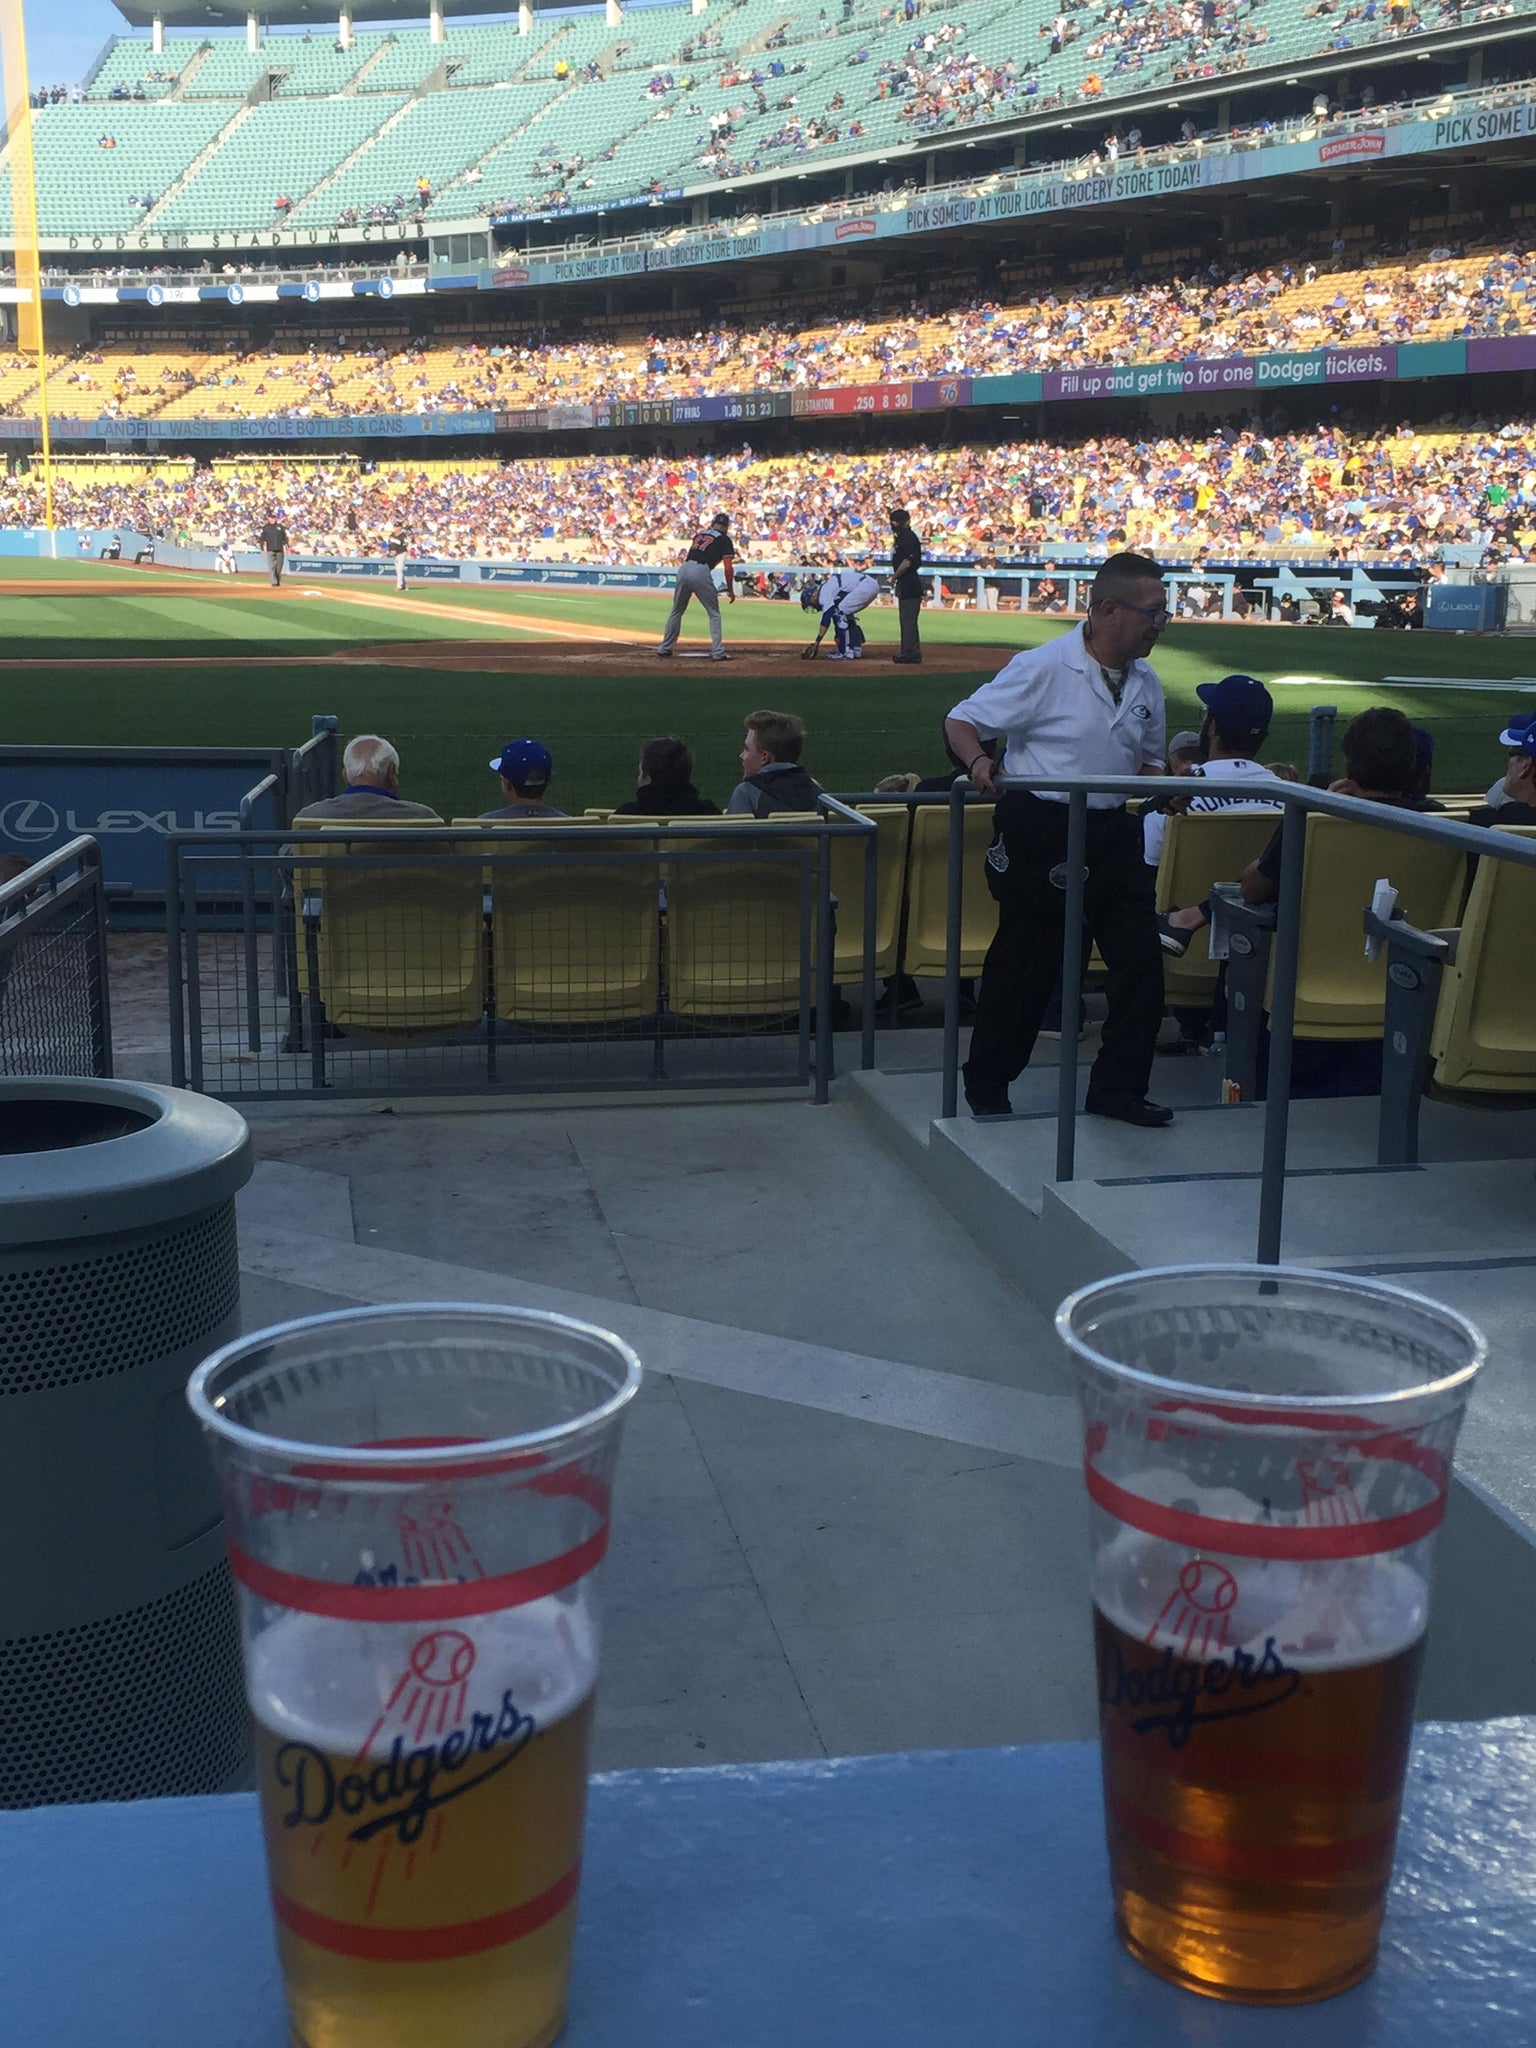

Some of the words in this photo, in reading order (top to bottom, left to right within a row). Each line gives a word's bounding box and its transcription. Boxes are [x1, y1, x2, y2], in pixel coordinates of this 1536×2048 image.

[1435, 117, 1473, 145] PICK
[1477, 108, 1522, 139] SOME
[1528, 107, 1536, 130] U
[1321, 141, 1357, 158] FARMER
[1357, 138, 1383, 150] JOHN
[906, 212, 929, 230] PICK
[932, 207, 959, 226] SOME
[962, 203, 976, 220] UP
[979, 200, 993, 218] AT
[994, 193, 1022, 214] YOUR
[1025, 189, 1059, 213] LOCAL
[1062, 177, 1113, 205] GROCERY
[1116, 171, 1154, 197] STORE
[1157, 163, 1201, 189] TODAY!
[70, 236, 189, 249] DODGER
[212, 230, 340, 248] STADIUM
[363, 224, 424, 241] CLUB
[555, 263, 574, 279] PICK
[576, 260, 597, 278] SOME
[599, 258, 609, 274] UP
[611, 257, 620, 274] AT
[621, 254, 641, 272] YOUR
[670, 244, 704, 265] GROCERY
[706, 240, 731, 260] STORE
[733, 235, 761, 257] TODAY!
[1060, 375, 1079, 393] Fill
[1083, 378, 1101, 394] up
[1105, 371, 1134, 390] and
[1138, 368, 1162, 393] get
[1166, 368, 1194, 386] two
[1198, 366, 1219, 384] for
[1223, 366, 1253, 382] one
[1258, 360, 1322, 382] Dodger
[1325, 353, 1388, 375] tickets.
[805, 397, 835, 412] STANTON
[853, 396, 875, 410] .250
[882, 395, 889, 409] 8
[894, 394, 908, 407] 30
[940, 382, 958, 404] 76
[643, 410, 649, 423] 0
[654, 409, 661, 422] 0
[665, 408, 671, 421] 1
[745, 403, 756, 416] 13
[760, 402, 771, 415] 23
[59, 422, 88, 436] OUT
[95, 422, 166, 437] LANDFILL
[169, 421, 223, 437] WASTE.
[230, 421, 293, 436] RECYCLE
[296, 419, 357, 435] BOTTLES
[358, 419, 366, 434] &
[369, 418, 406, 434] CANS.
[66, 810, 241, 834] LEXUS
[1098, 1636, 1301, 1750] Dodgers
[276, 1688, 536, 1844] Dodgers
